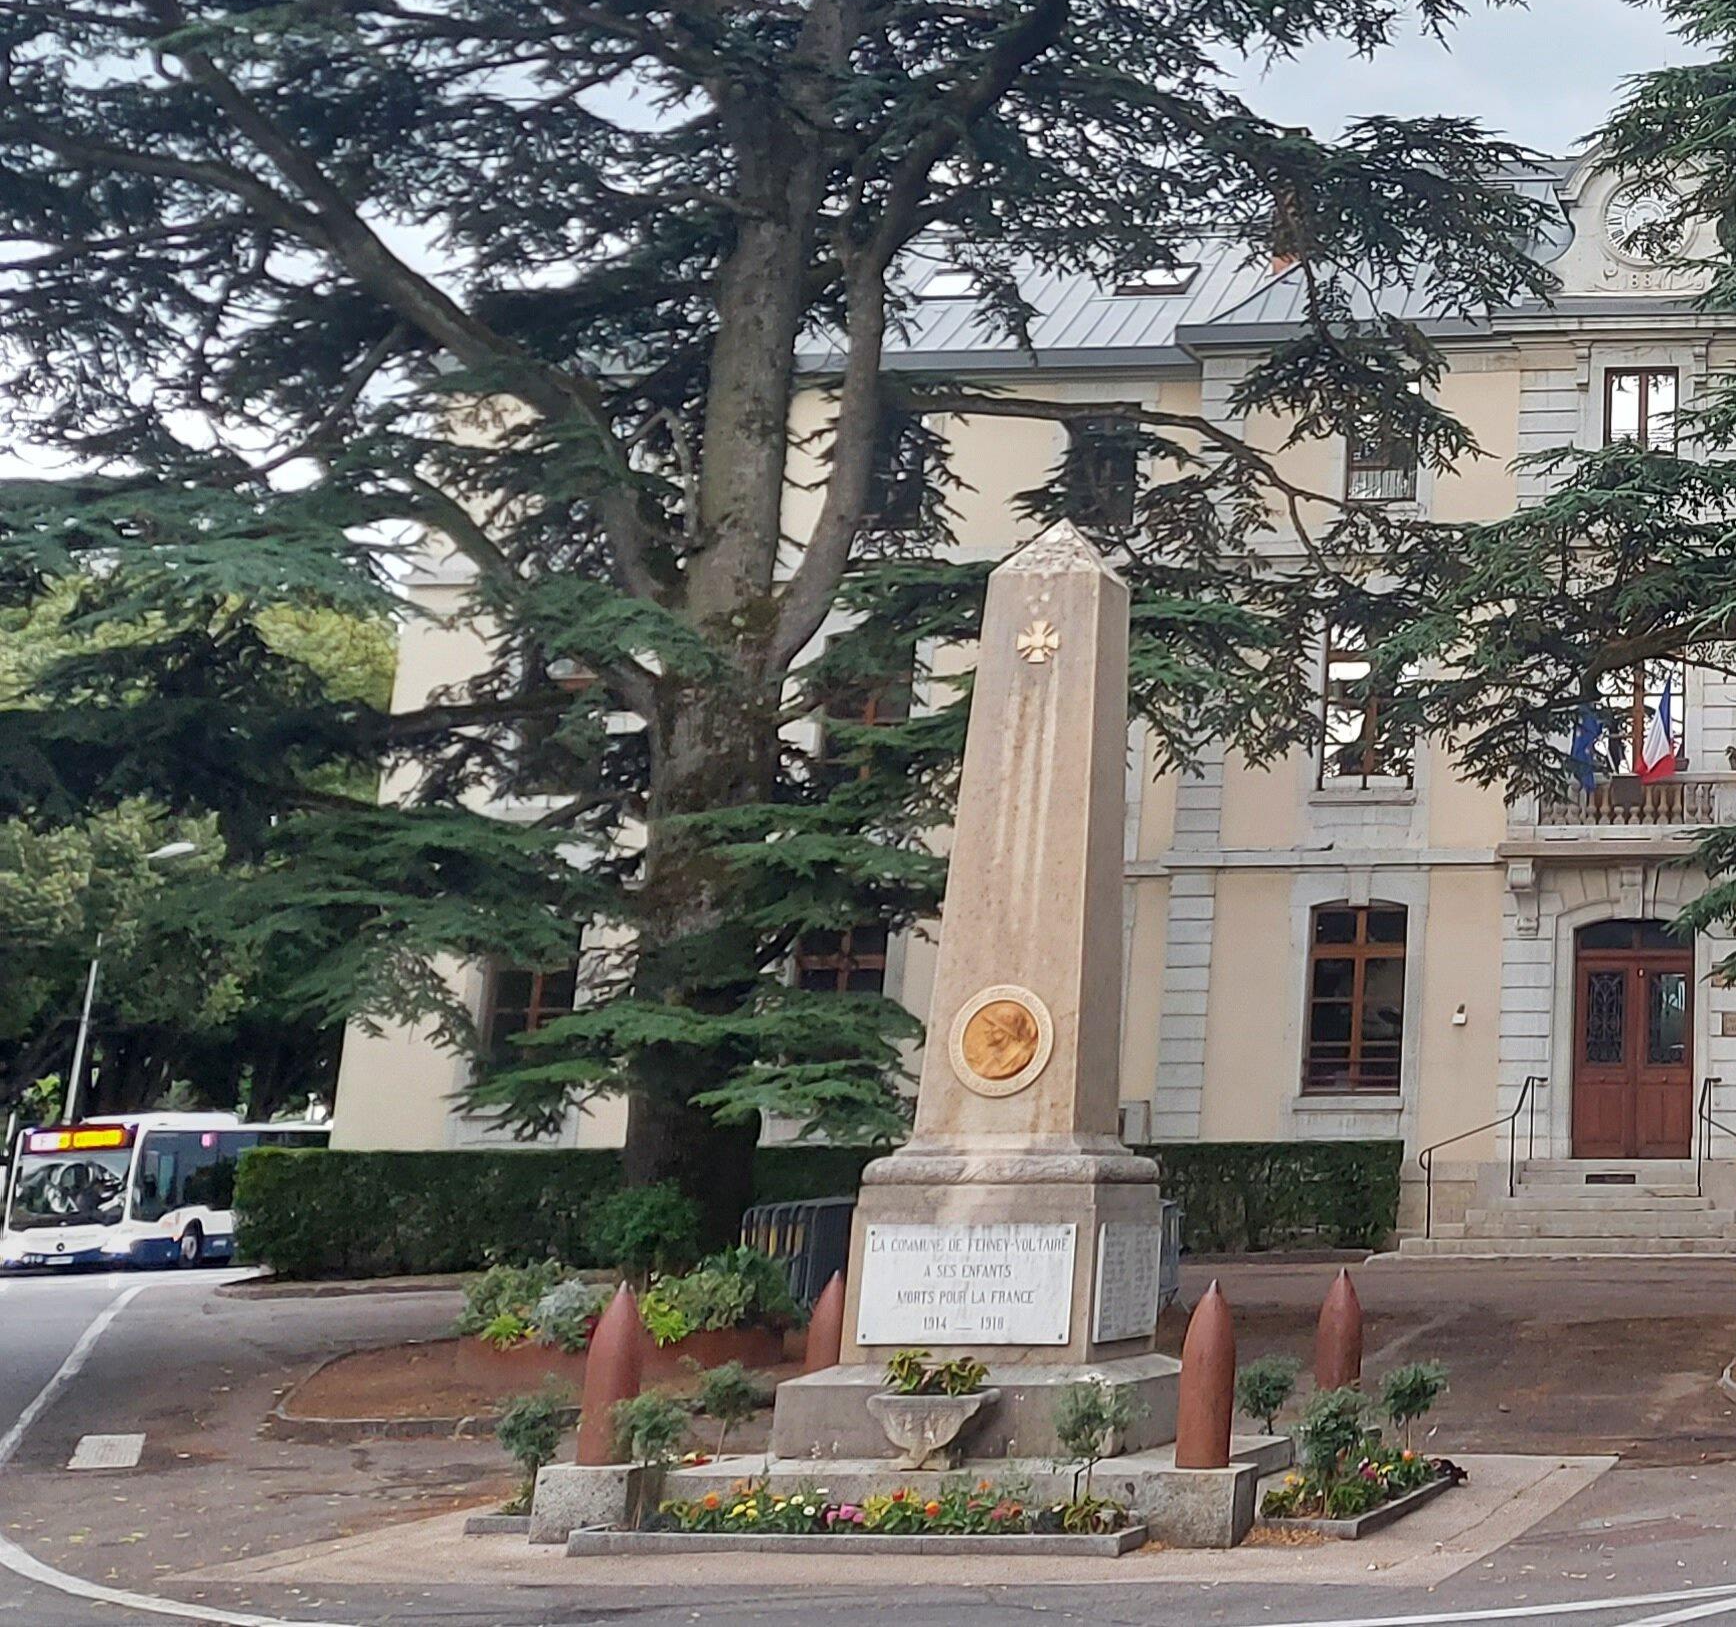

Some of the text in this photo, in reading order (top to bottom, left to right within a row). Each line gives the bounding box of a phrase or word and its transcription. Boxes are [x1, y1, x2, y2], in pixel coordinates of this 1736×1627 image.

[872, 1238, 885, 1252] LA
[890, 1238, 943, 1252] COMMUNE
[949, 1238, 963, 1252] DE
[923, 1264, 1012, 1278] A SES ENFANTS
[897, 1290, 1034, 1304] MORTS POUR LA FRANCE
[923, 1316, 1004, 1330] 1914 1918
